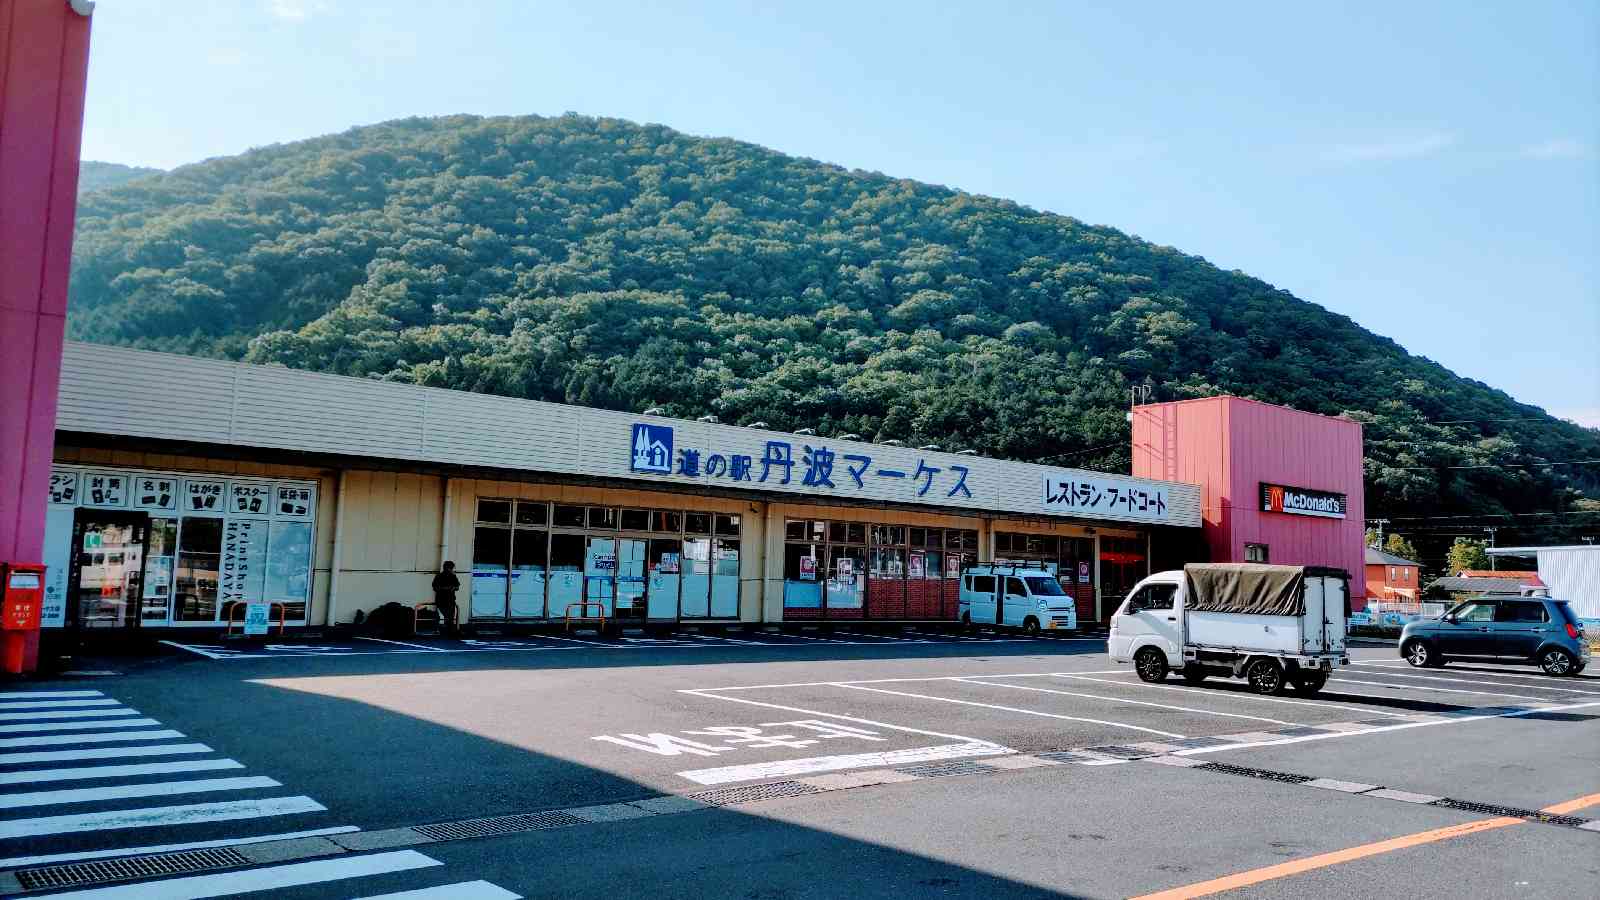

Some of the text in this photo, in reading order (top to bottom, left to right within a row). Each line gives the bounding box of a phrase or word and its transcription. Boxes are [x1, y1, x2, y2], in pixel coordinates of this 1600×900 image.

[676, 441, 972, 497] 道の駅 丹波マーケス
[144, 481, 170, 492] 名刺
[189, 484, 221, 495] はがき
[233, 487, 268, 496] ポスター
[1284, 491, 1340, 512] McDonald's
[223, 522, 237, 599] HANADAYA
